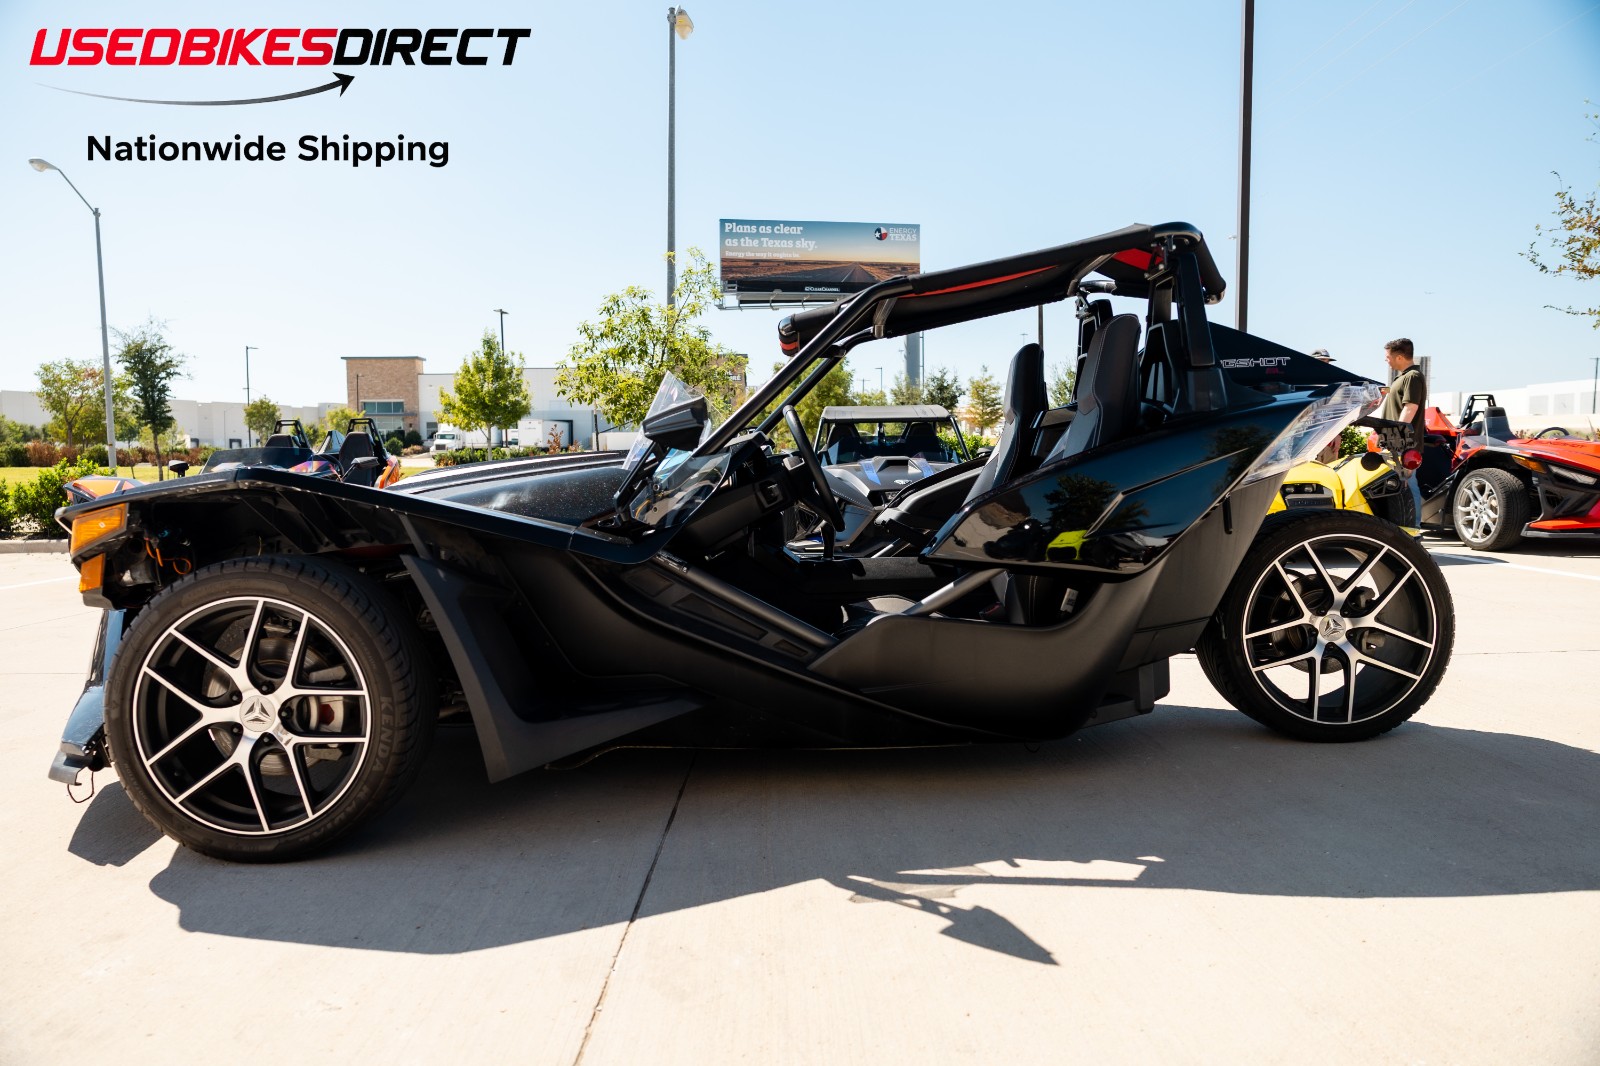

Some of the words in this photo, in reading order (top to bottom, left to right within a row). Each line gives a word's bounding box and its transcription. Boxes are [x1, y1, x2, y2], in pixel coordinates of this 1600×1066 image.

[724, 222, 757, 233] Plans
[759, 225, 772, 234] as
[773, 223, 803, 235] clear
[890, 233, 917, 241] TEXAS
[725, 238, 738, 247] as
[740, 237, 759, 247] the
[761, 237, 794, 248] Texas
[795, 238, 818, 251] sky.
[725, 250, 745, 258] Energy
[1220, 357, 1291, 368] GSHOT
